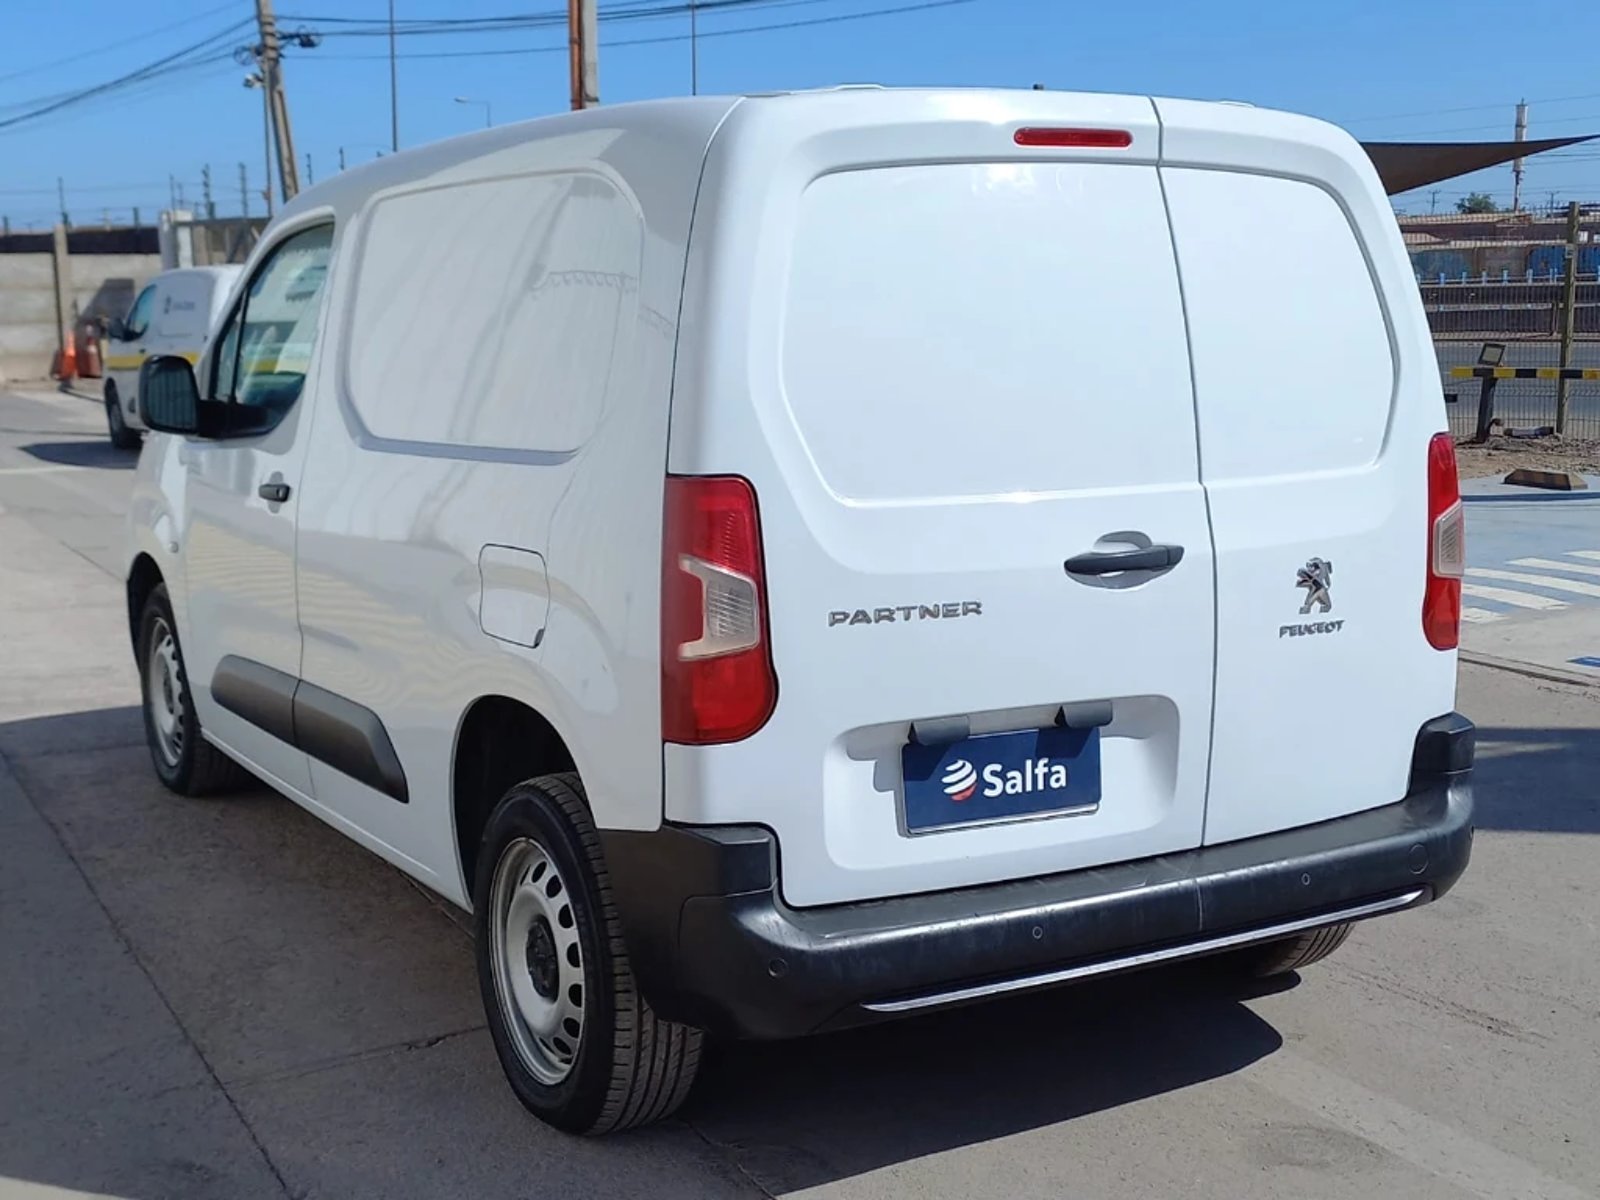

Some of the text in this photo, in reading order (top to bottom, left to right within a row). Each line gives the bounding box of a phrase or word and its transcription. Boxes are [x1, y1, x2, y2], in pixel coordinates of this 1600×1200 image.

[828, 601, 983, 627] PARTNER
[1279, 619, 1346, 639] PEUGEOT
[982, 756, 1067, 798] Salfa
